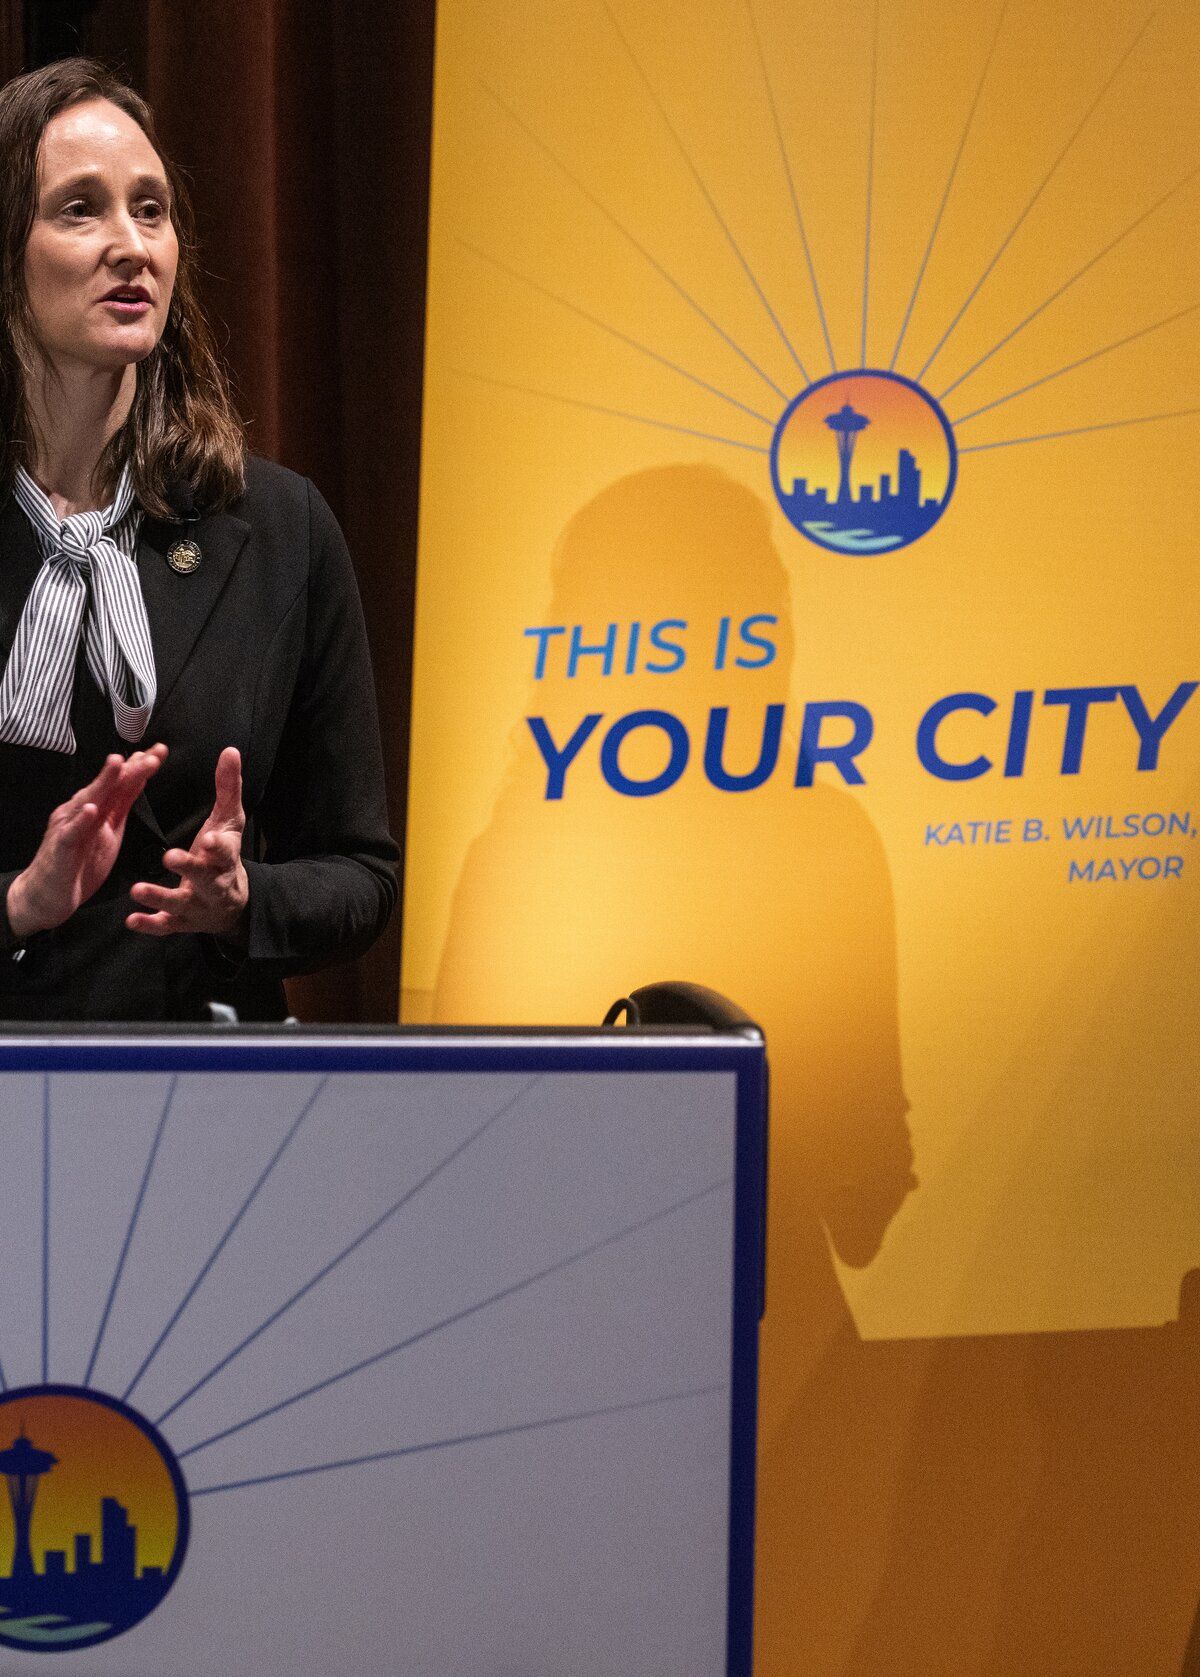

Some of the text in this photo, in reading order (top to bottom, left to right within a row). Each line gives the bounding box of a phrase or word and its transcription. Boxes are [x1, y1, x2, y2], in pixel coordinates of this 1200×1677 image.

[522, 612, 780, 682] THIS IS
[524, 681, 1200, 802] YOUR CITY
[923, 810, 1199, 848] KATIE B. WILSON,
[1067, 854, 1186, 883] MAYOR
